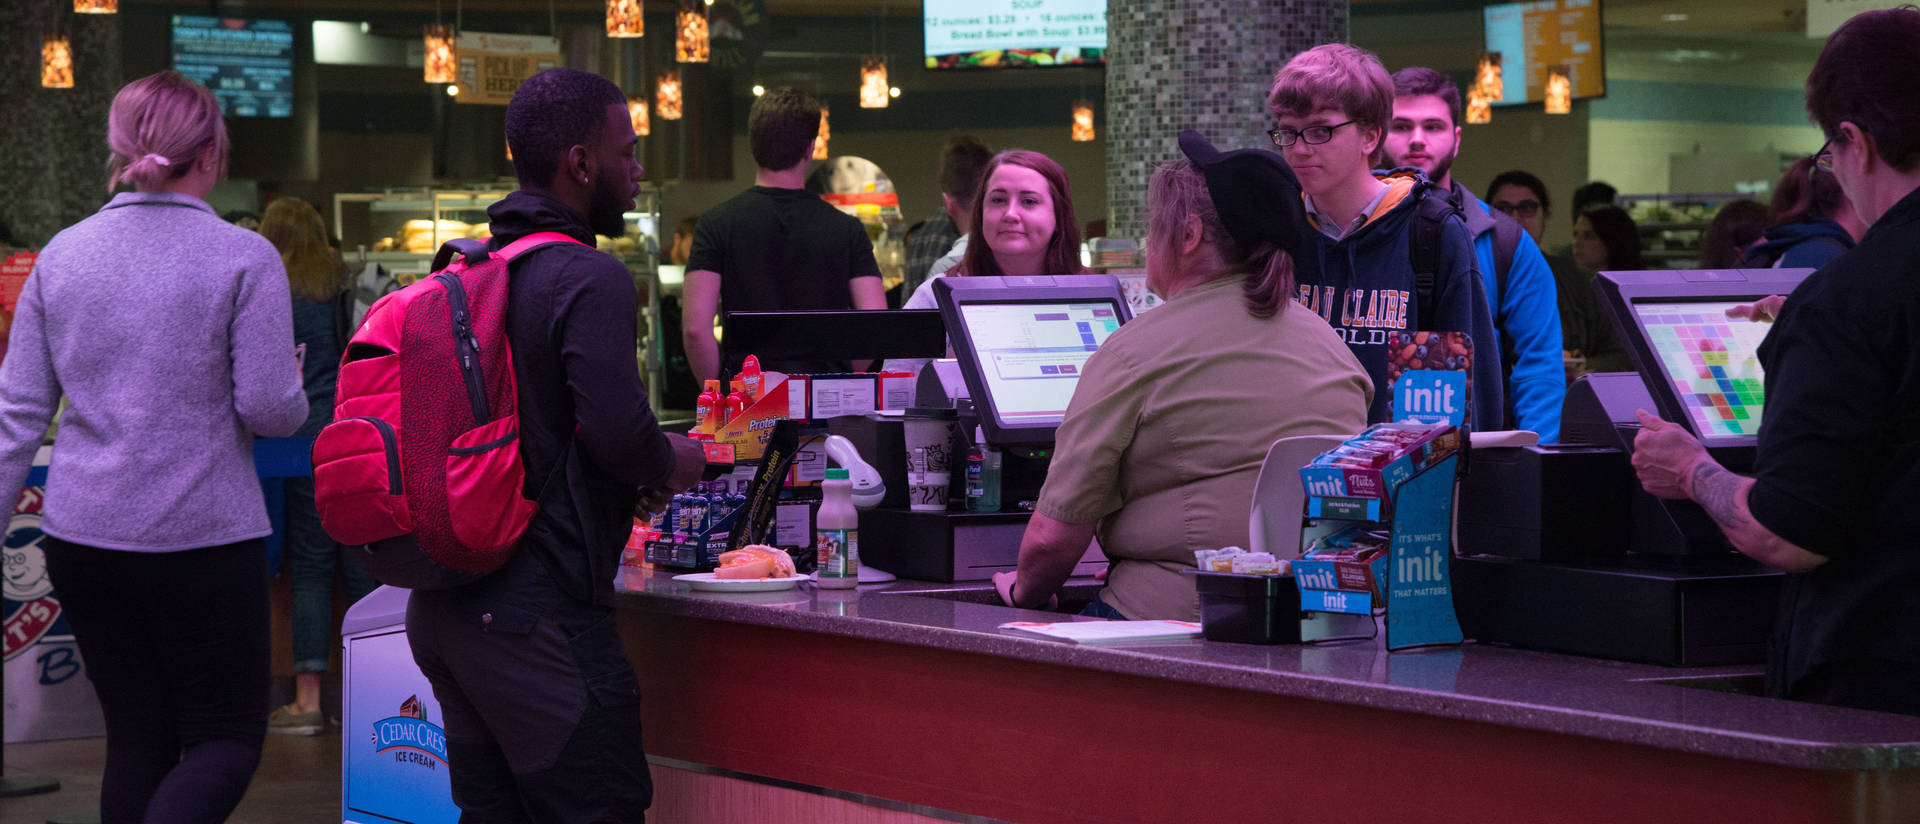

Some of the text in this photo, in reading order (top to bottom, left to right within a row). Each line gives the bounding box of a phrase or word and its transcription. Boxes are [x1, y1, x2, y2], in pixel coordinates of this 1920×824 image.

[1012, 0, 1043, 9] SOUP
[951, 29, 983, 40] Bread
[986, 28, 1013, 39] Bowl
[1017, 27, 1038, 37] with
[1300, 284, 1335, 324] EAU
[1341, 289, 1410, 329] CLAIRE
[1404, 378, 1455, 414] init
[762, 449, 781, 482] Protein
[1307, 475, 1345, 496] init
[1349, 474, 1376, 489] Nuts
[1398, 533, 1442, 543] IT'S WHAT'S
[1397, 546, 1444, 583] init
[1297, 568, 1339, 590] init
[1323, 591, 1347, 609] init
[1394, 587, 1448, 598] THAT MATTERS
[380, 722, 416, 745] CEDAR
[395, 751, 436, 770] ICE CREAM
